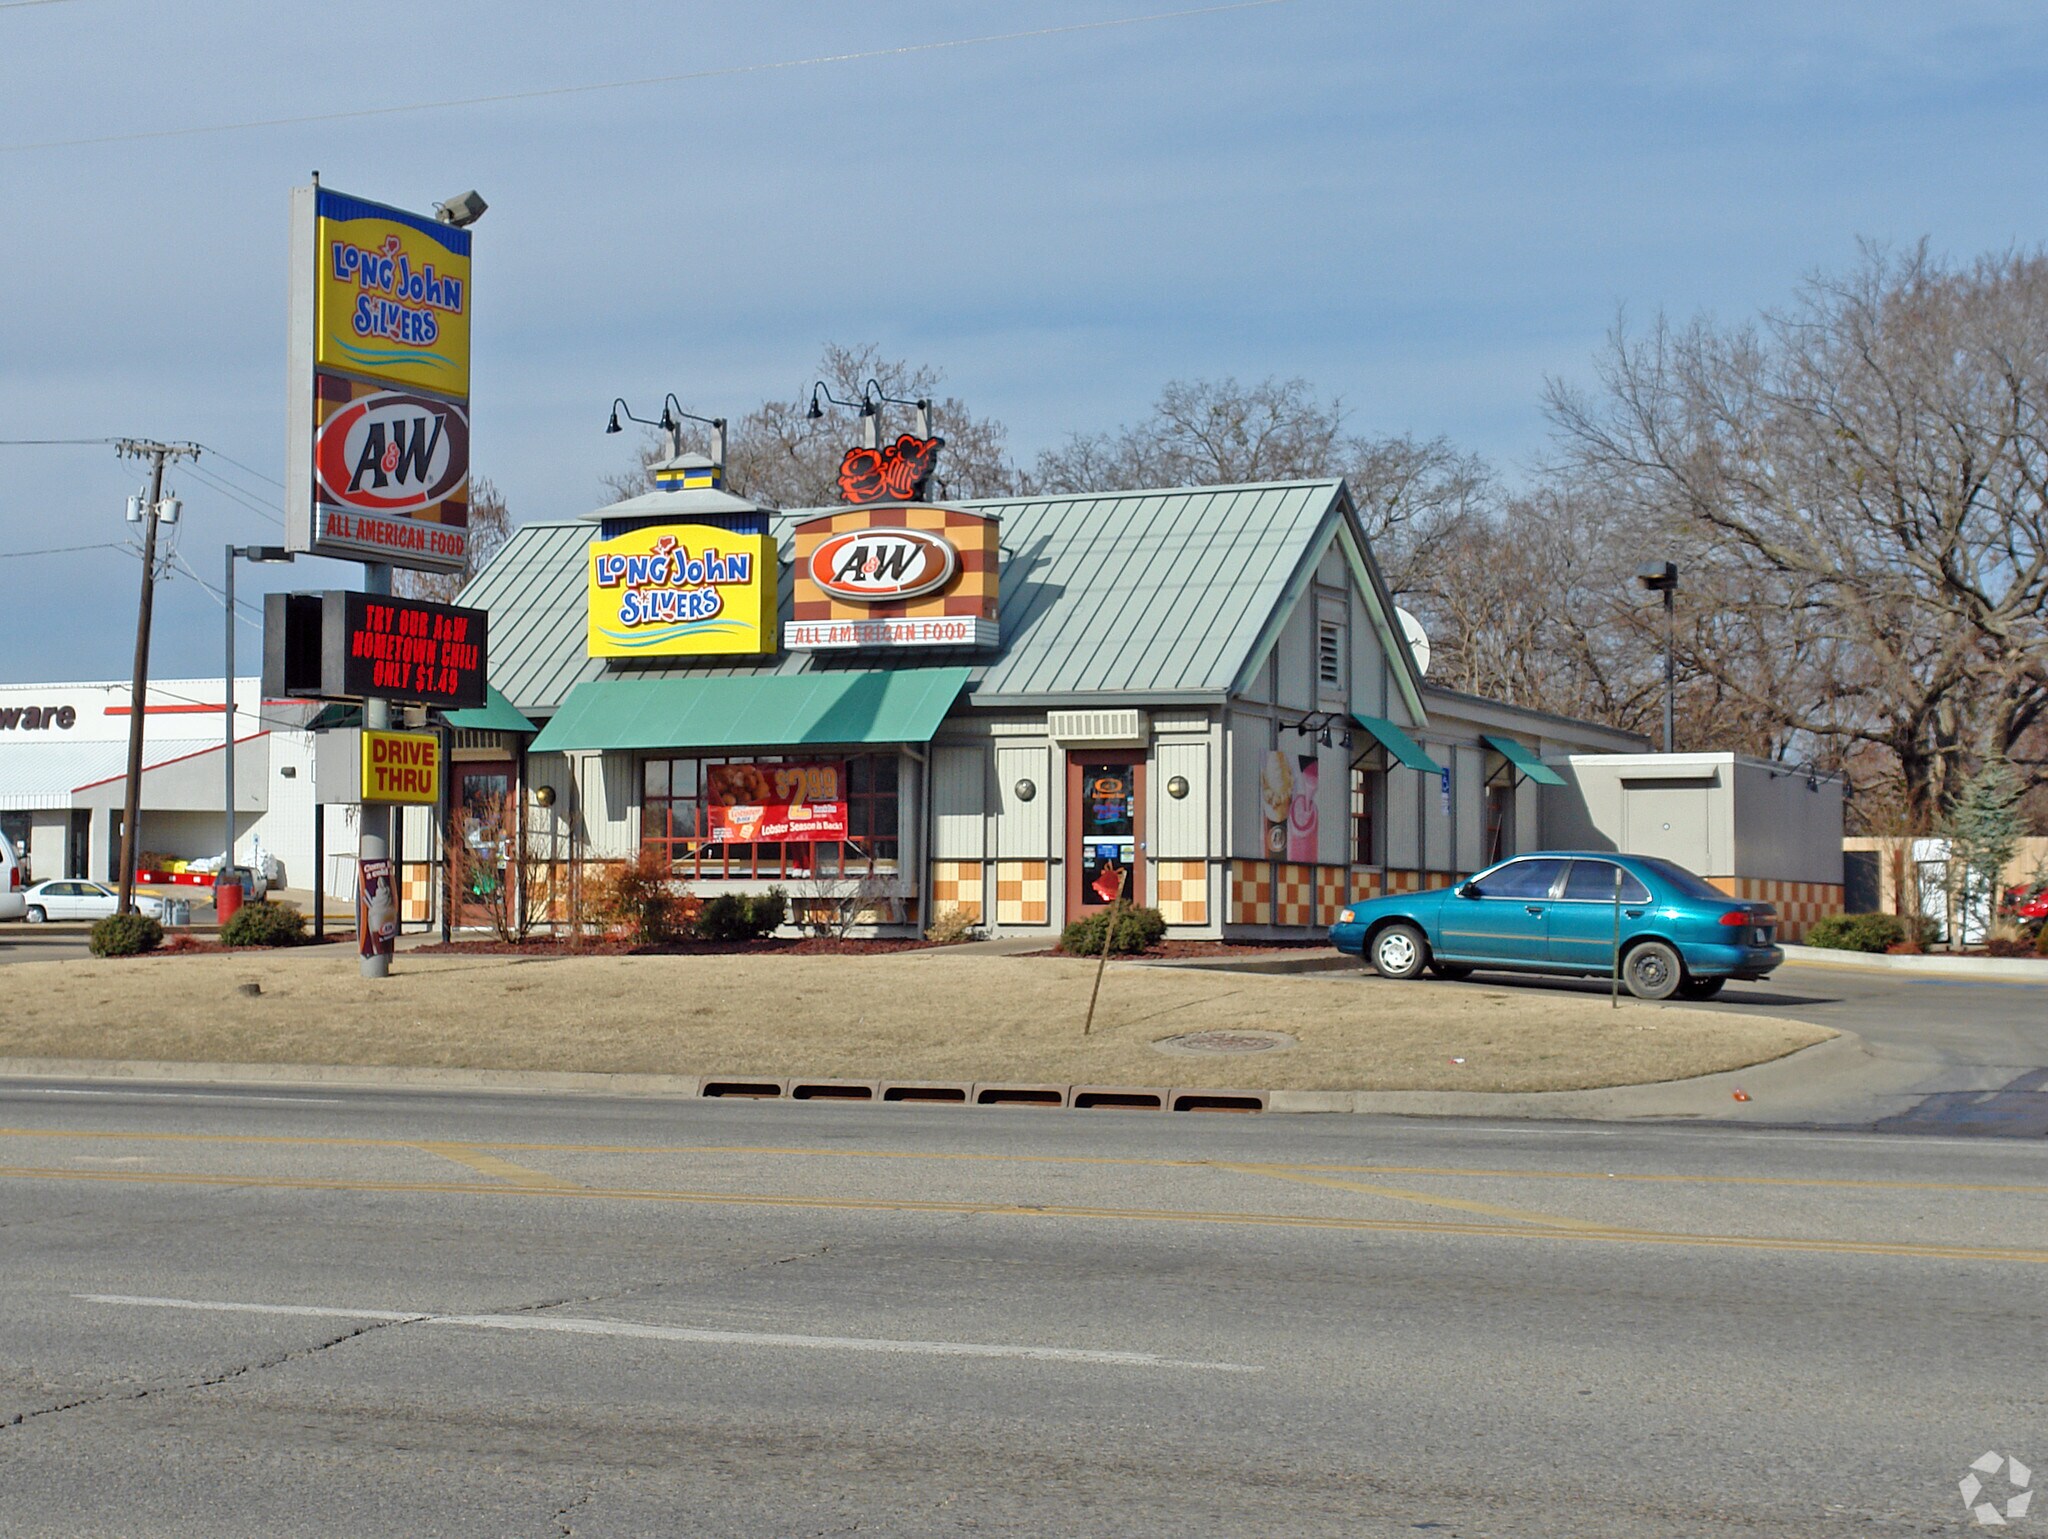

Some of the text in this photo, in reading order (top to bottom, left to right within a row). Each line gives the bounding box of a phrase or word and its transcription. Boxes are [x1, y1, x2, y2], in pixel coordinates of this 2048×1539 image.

[347, 414, 446, 492] A&W
[326, 512, 465, 556] ALL AMERICAN FOOD
[833, 544, 925, 583] A&W
[366, 604, 468, 642] TRY OUR A&W
[795, 622, 967, 645] ALL AMERICAN FOOD
[352, 630, 478, 671] HOMETOWN CHILI
[373, 660, 458, 696] ONLY $1.49
[0, 704, 76, 730] ware
[372, 738, 435, 767] DRIVE
[375, 767, 432, 794] THRU
[761, 824, 789, 836] Lobster
[789, 822, 816, 833] Season
